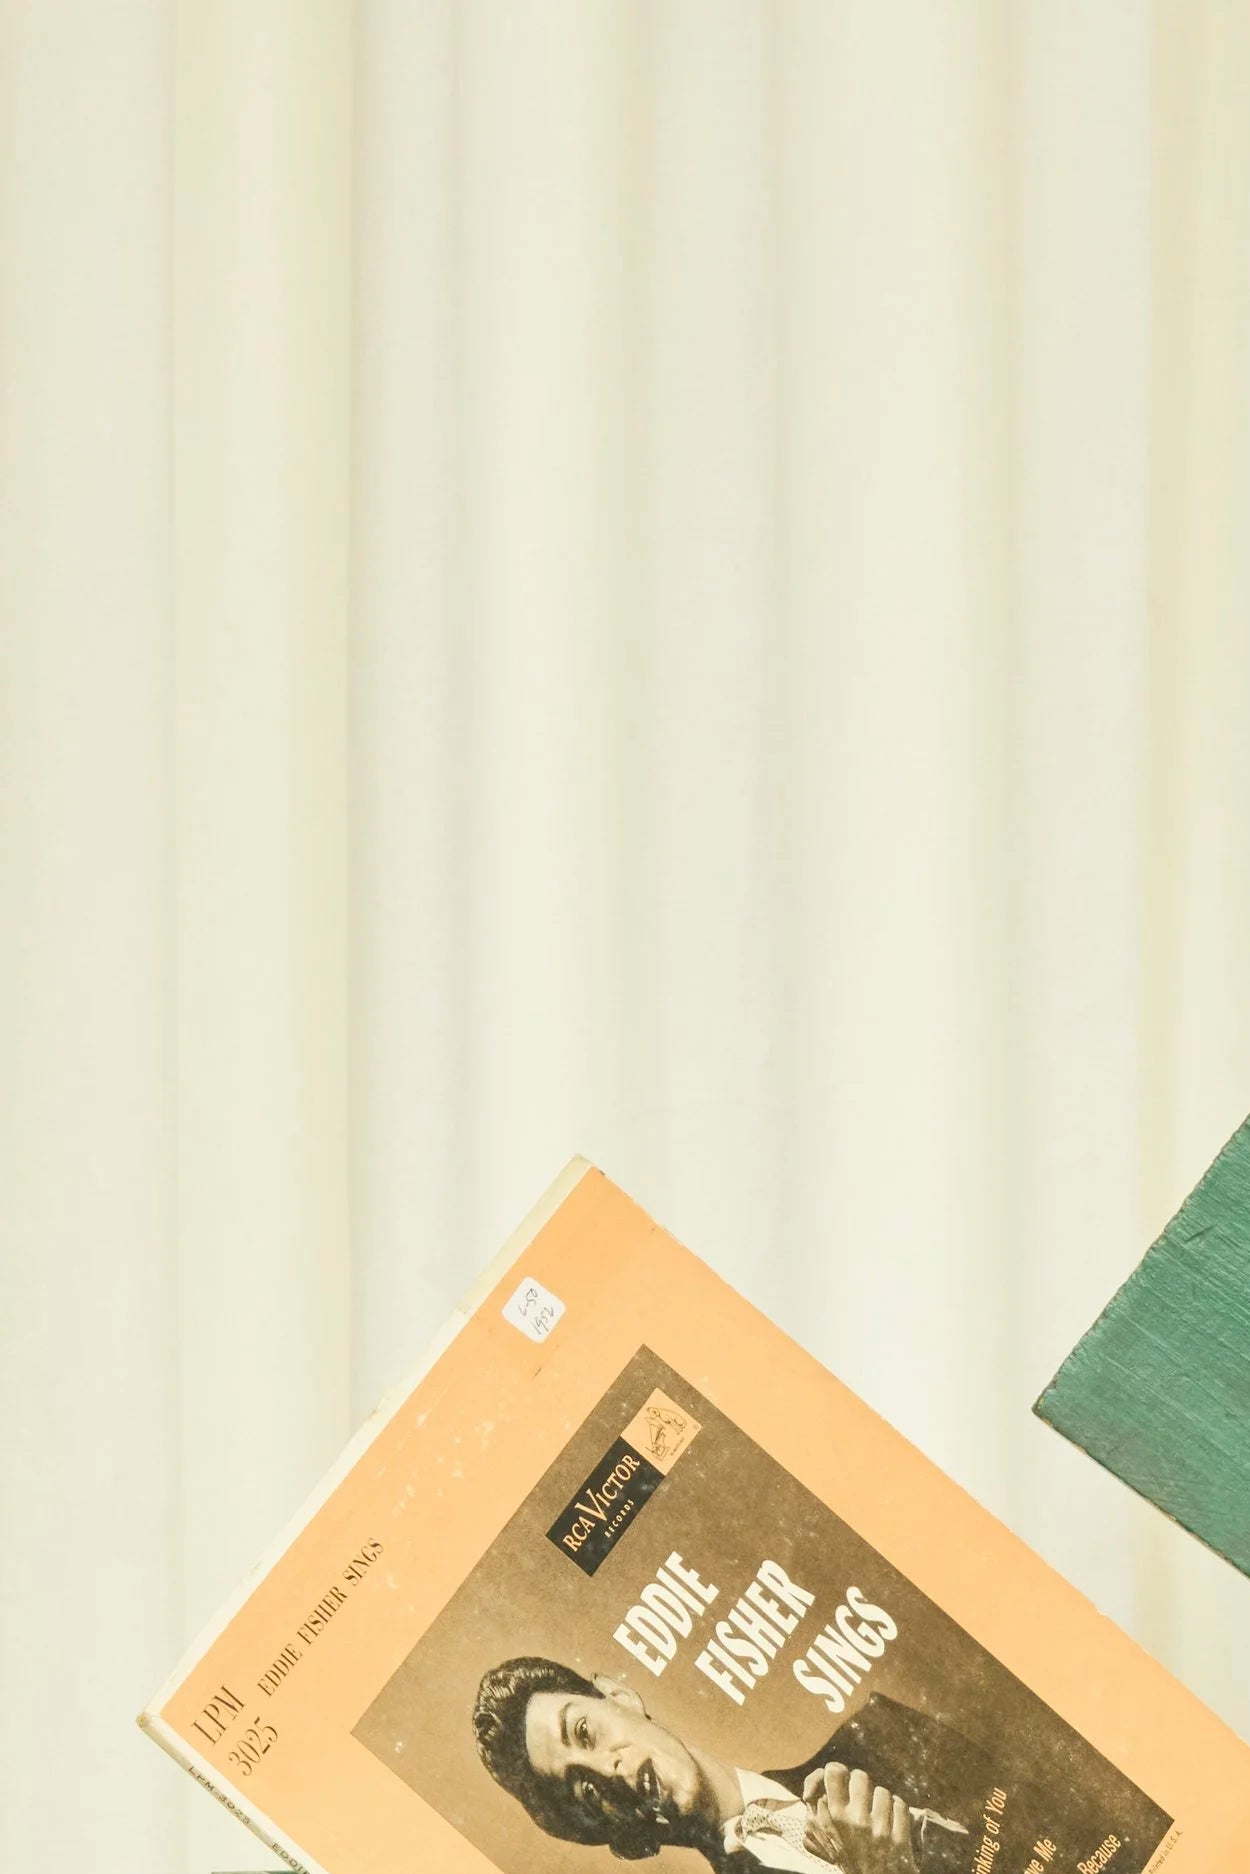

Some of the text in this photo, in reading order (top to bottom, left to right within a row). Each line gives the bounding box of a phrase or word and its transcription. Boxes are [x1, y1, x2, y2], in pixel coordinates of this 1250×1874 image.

[604, 1498, 635, 1538] RECORDS
[257, 1537, 384, 1698] EDDIE FISHER SINGS
[612, 1550, 720, 1677] EDDIE
[694, 1559, 816, 1706] FISHER
[792, 1585, 898, 1714] SINGS
[190, 1684, 246, 1746] LPM
[228, 1716, 279, 1777] 3025
[983, 1813, 1001, 1835] of
[985, 1786, 1007, 1815] You
[1033, 1838, 1057, 1862] Me
